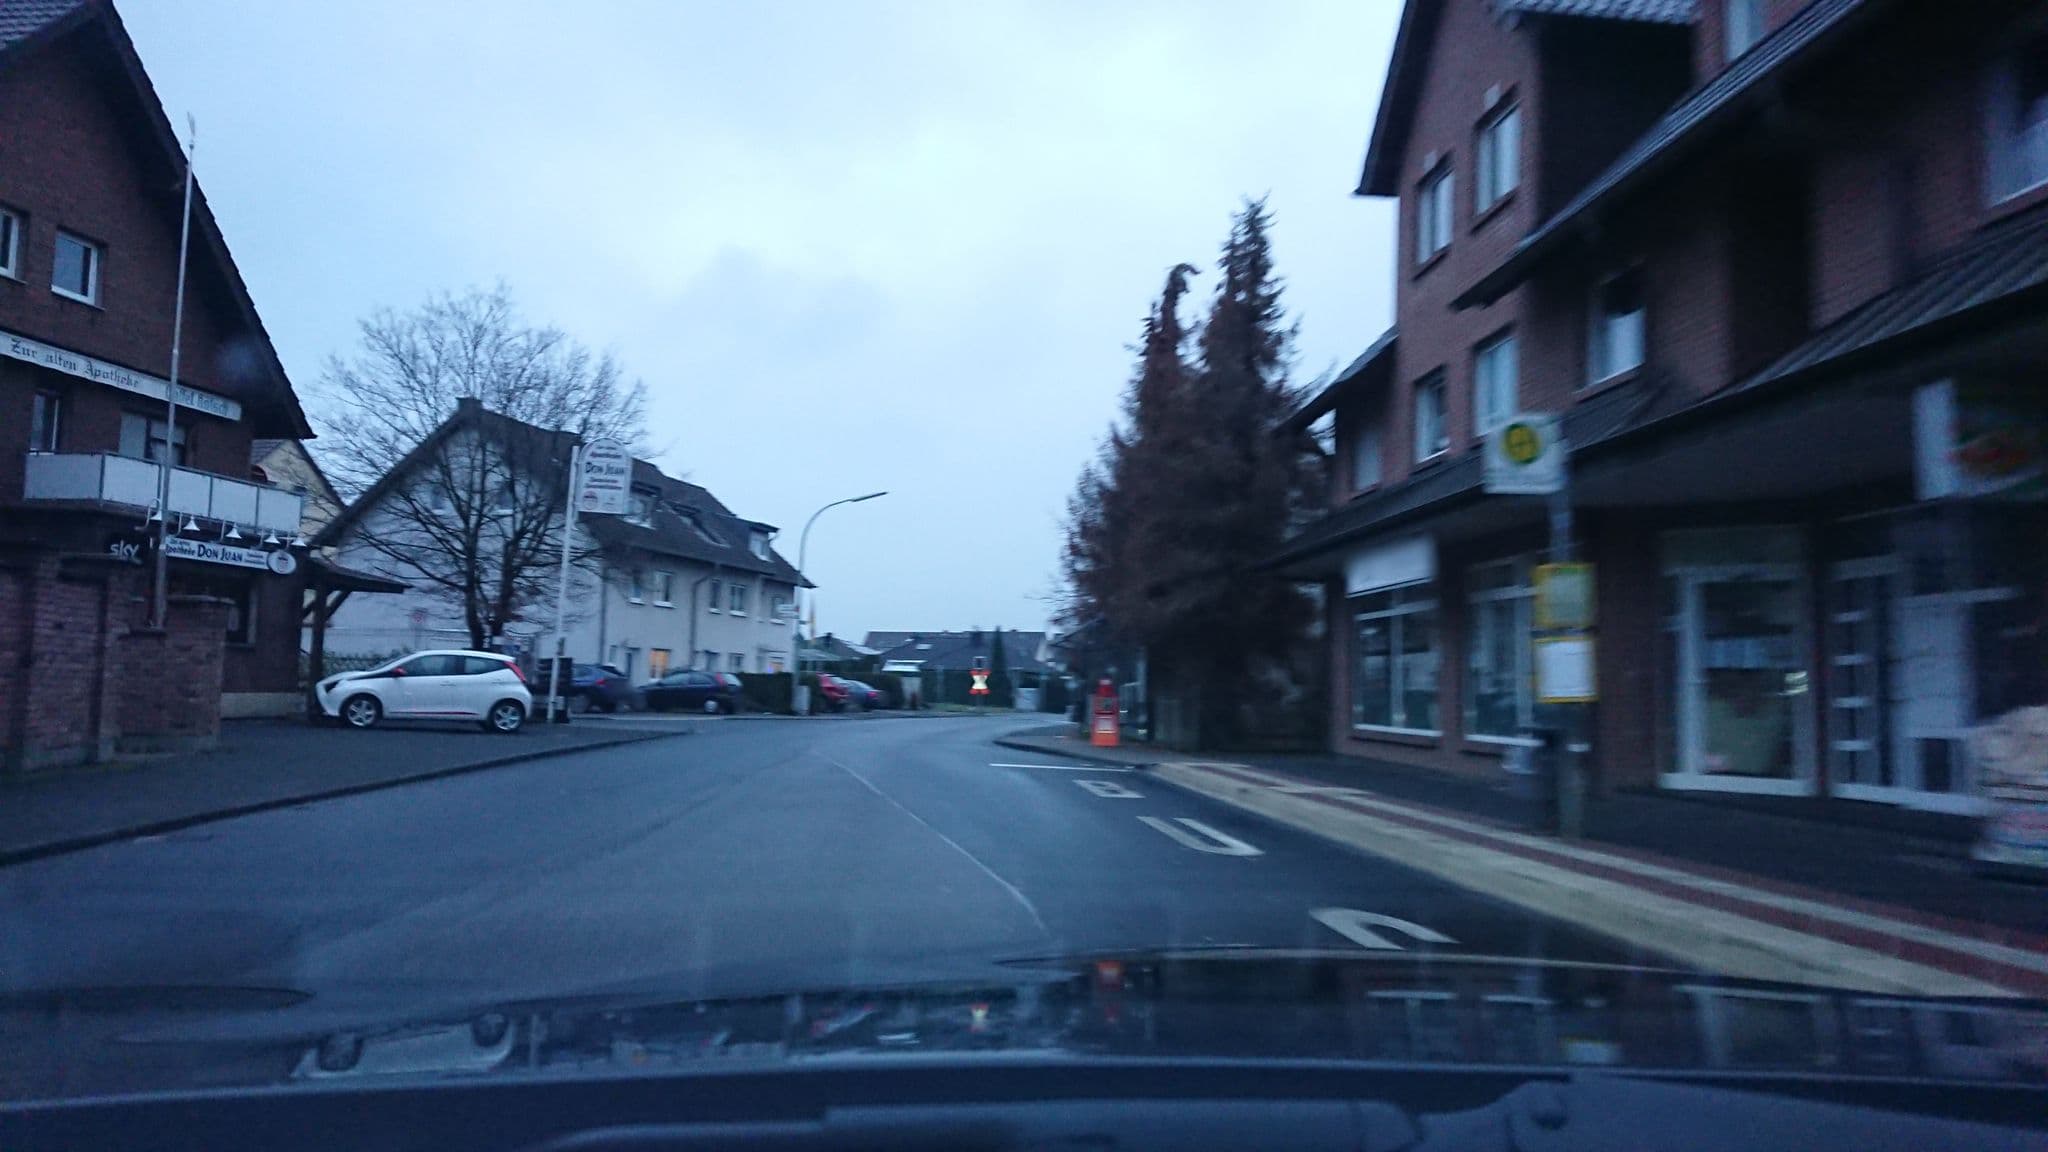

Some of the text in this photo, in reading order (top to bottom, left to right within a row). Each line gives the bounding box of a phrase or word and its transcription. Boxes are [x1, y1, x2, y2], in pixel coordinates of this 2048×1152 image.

[10, 338, 140, 389] Zur alten Apotheke
[110, 540, 139, 559] sky
